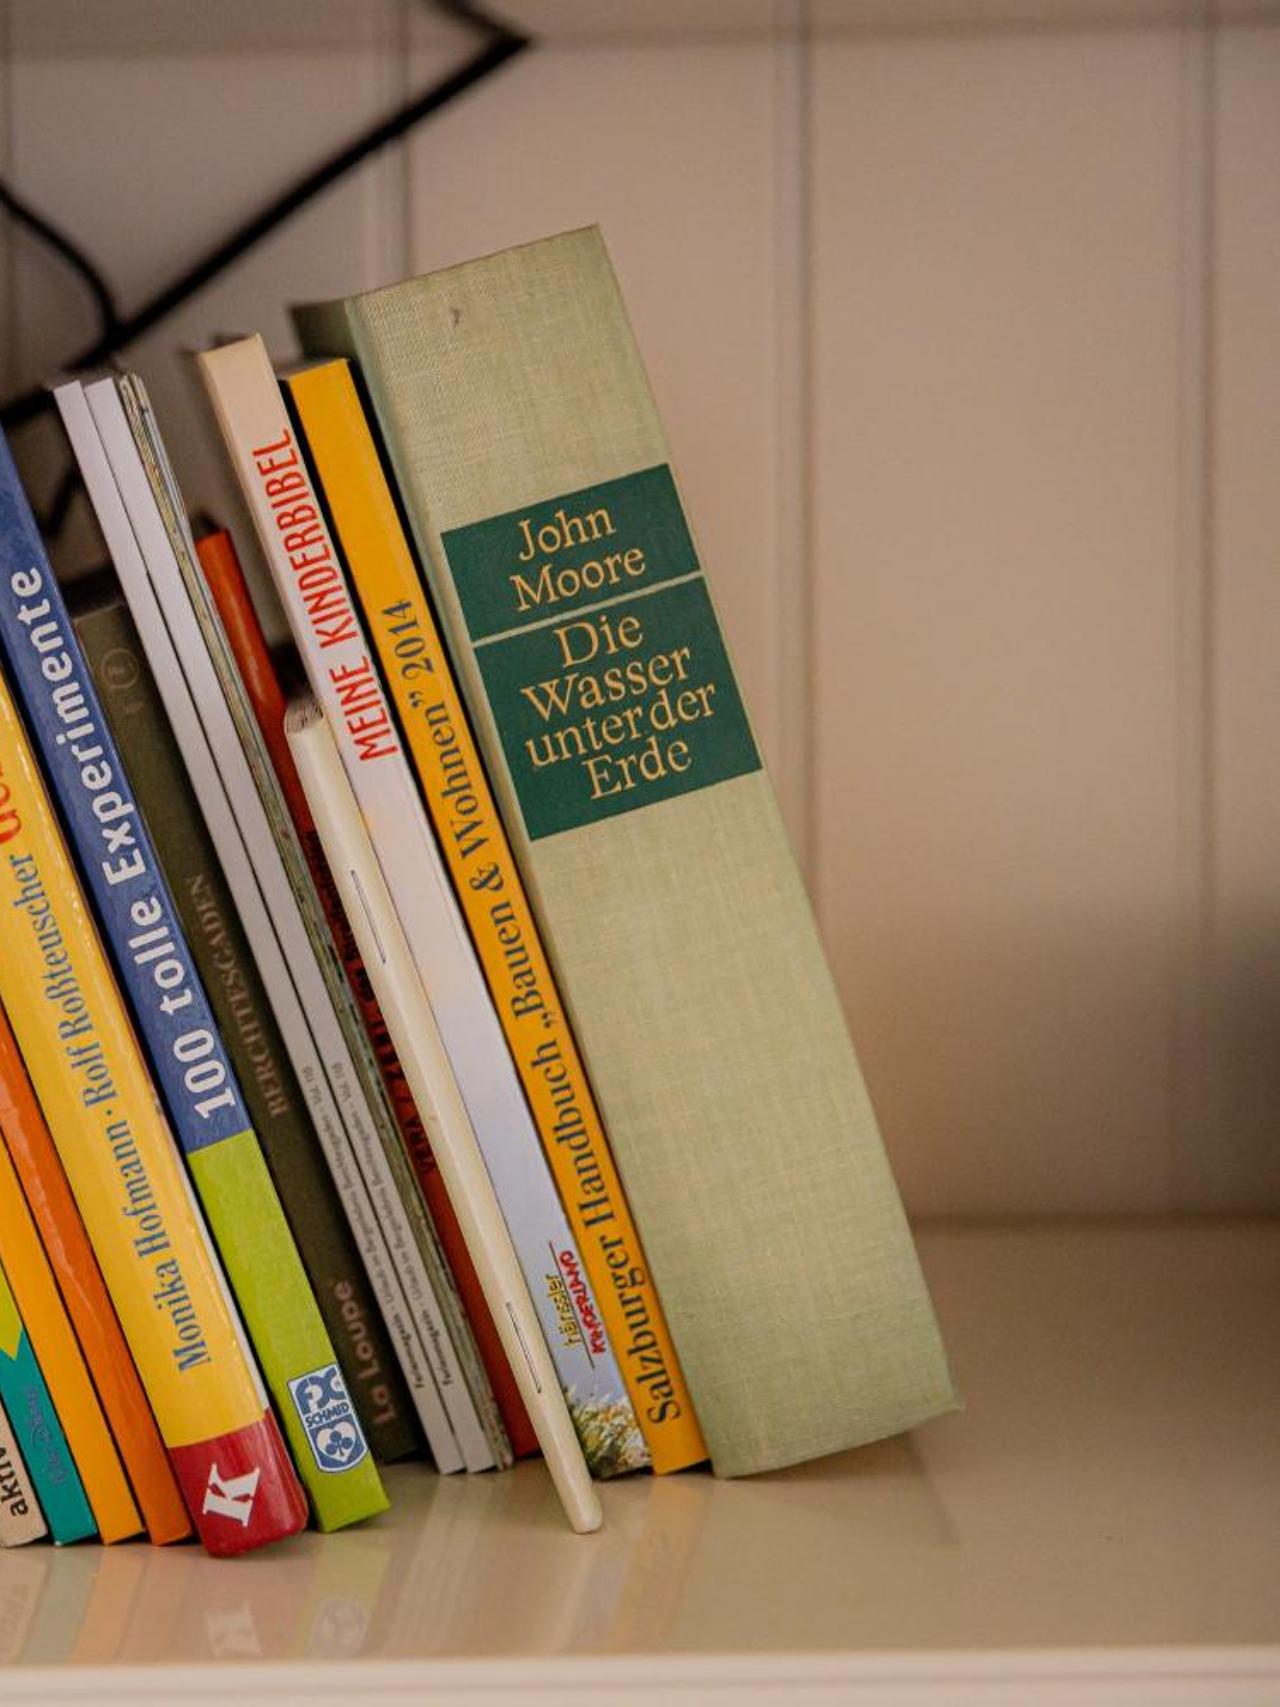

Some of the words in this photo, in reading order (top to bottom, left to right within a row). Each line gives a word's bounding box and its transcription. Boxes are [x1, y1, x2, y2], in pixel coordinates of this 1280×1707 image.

[251, 428, 359, 650] KINDERBIBEL
[518, 504, 618, 561] John
[509, 546, 647, 612] Moore
[381, 600, 435, 681] 2014
[520, 646, 692, 723] Wasser
[552, 613, 644, 669] Die
[11, 567, 147, 887] Experimente
[328, 654, 400, 763] MEINE
[524, 705, 644, 769] unter
[648, 681, 717, 732] der
[580, 735, 694, 801] Erde
[469, 861, 505, 892] &
[10, 852, 94, 1048] Roßteuscher
[128, 897, 193, 1015] tolle
[185, 873, 289, 1116] BERCHTESGADEN
[69, 1044, 118, 1108] Rolf
[174, 1029, 236, 1119] 100
[530, 1039, 616, 1228] Handbuch
[105, 1119, 171, 1258] Hofmann
[154, 1258, 212, 1373] Monika
[333, 1278, 380, 1382] Loupe
[599, 1234, 681, 1425] Salzburger
[368, 1384, 396, 1427] La
[202, 1462, 261, 1528] K
